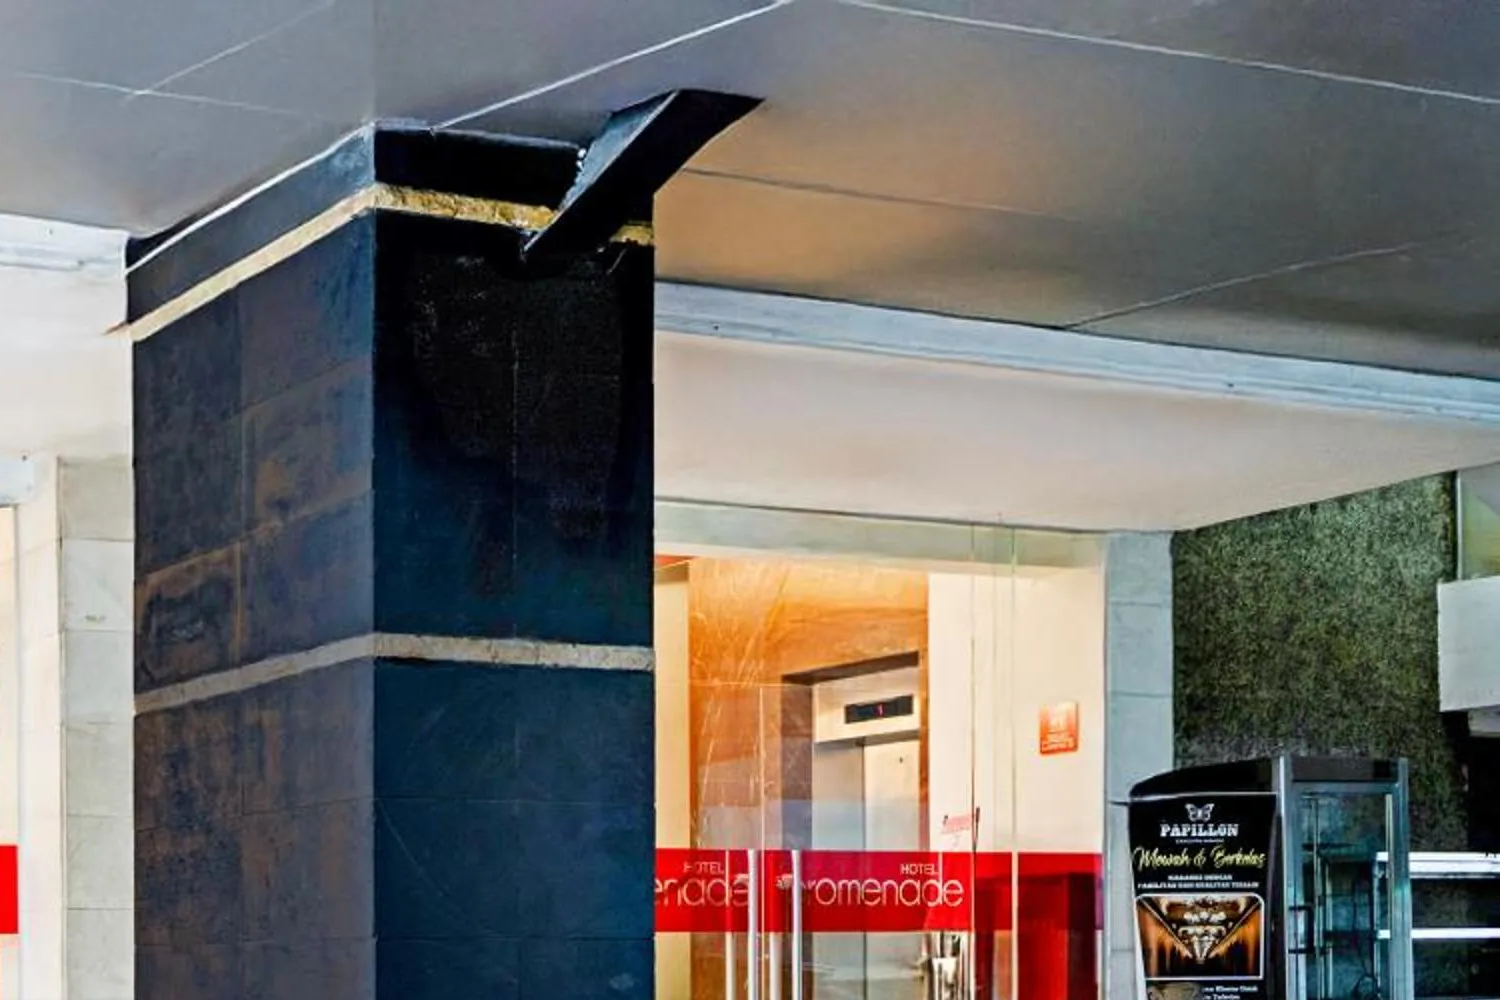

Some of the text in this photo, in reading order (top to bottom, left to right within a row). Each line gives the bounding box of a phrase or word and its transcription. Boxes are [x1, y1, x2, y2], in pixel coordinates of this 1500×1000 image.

[1159, 823, 1240, 838] PAPILLON
[683, 861, 725, 875] HOTEL
[900, 863, 939, 876] HOTEL
